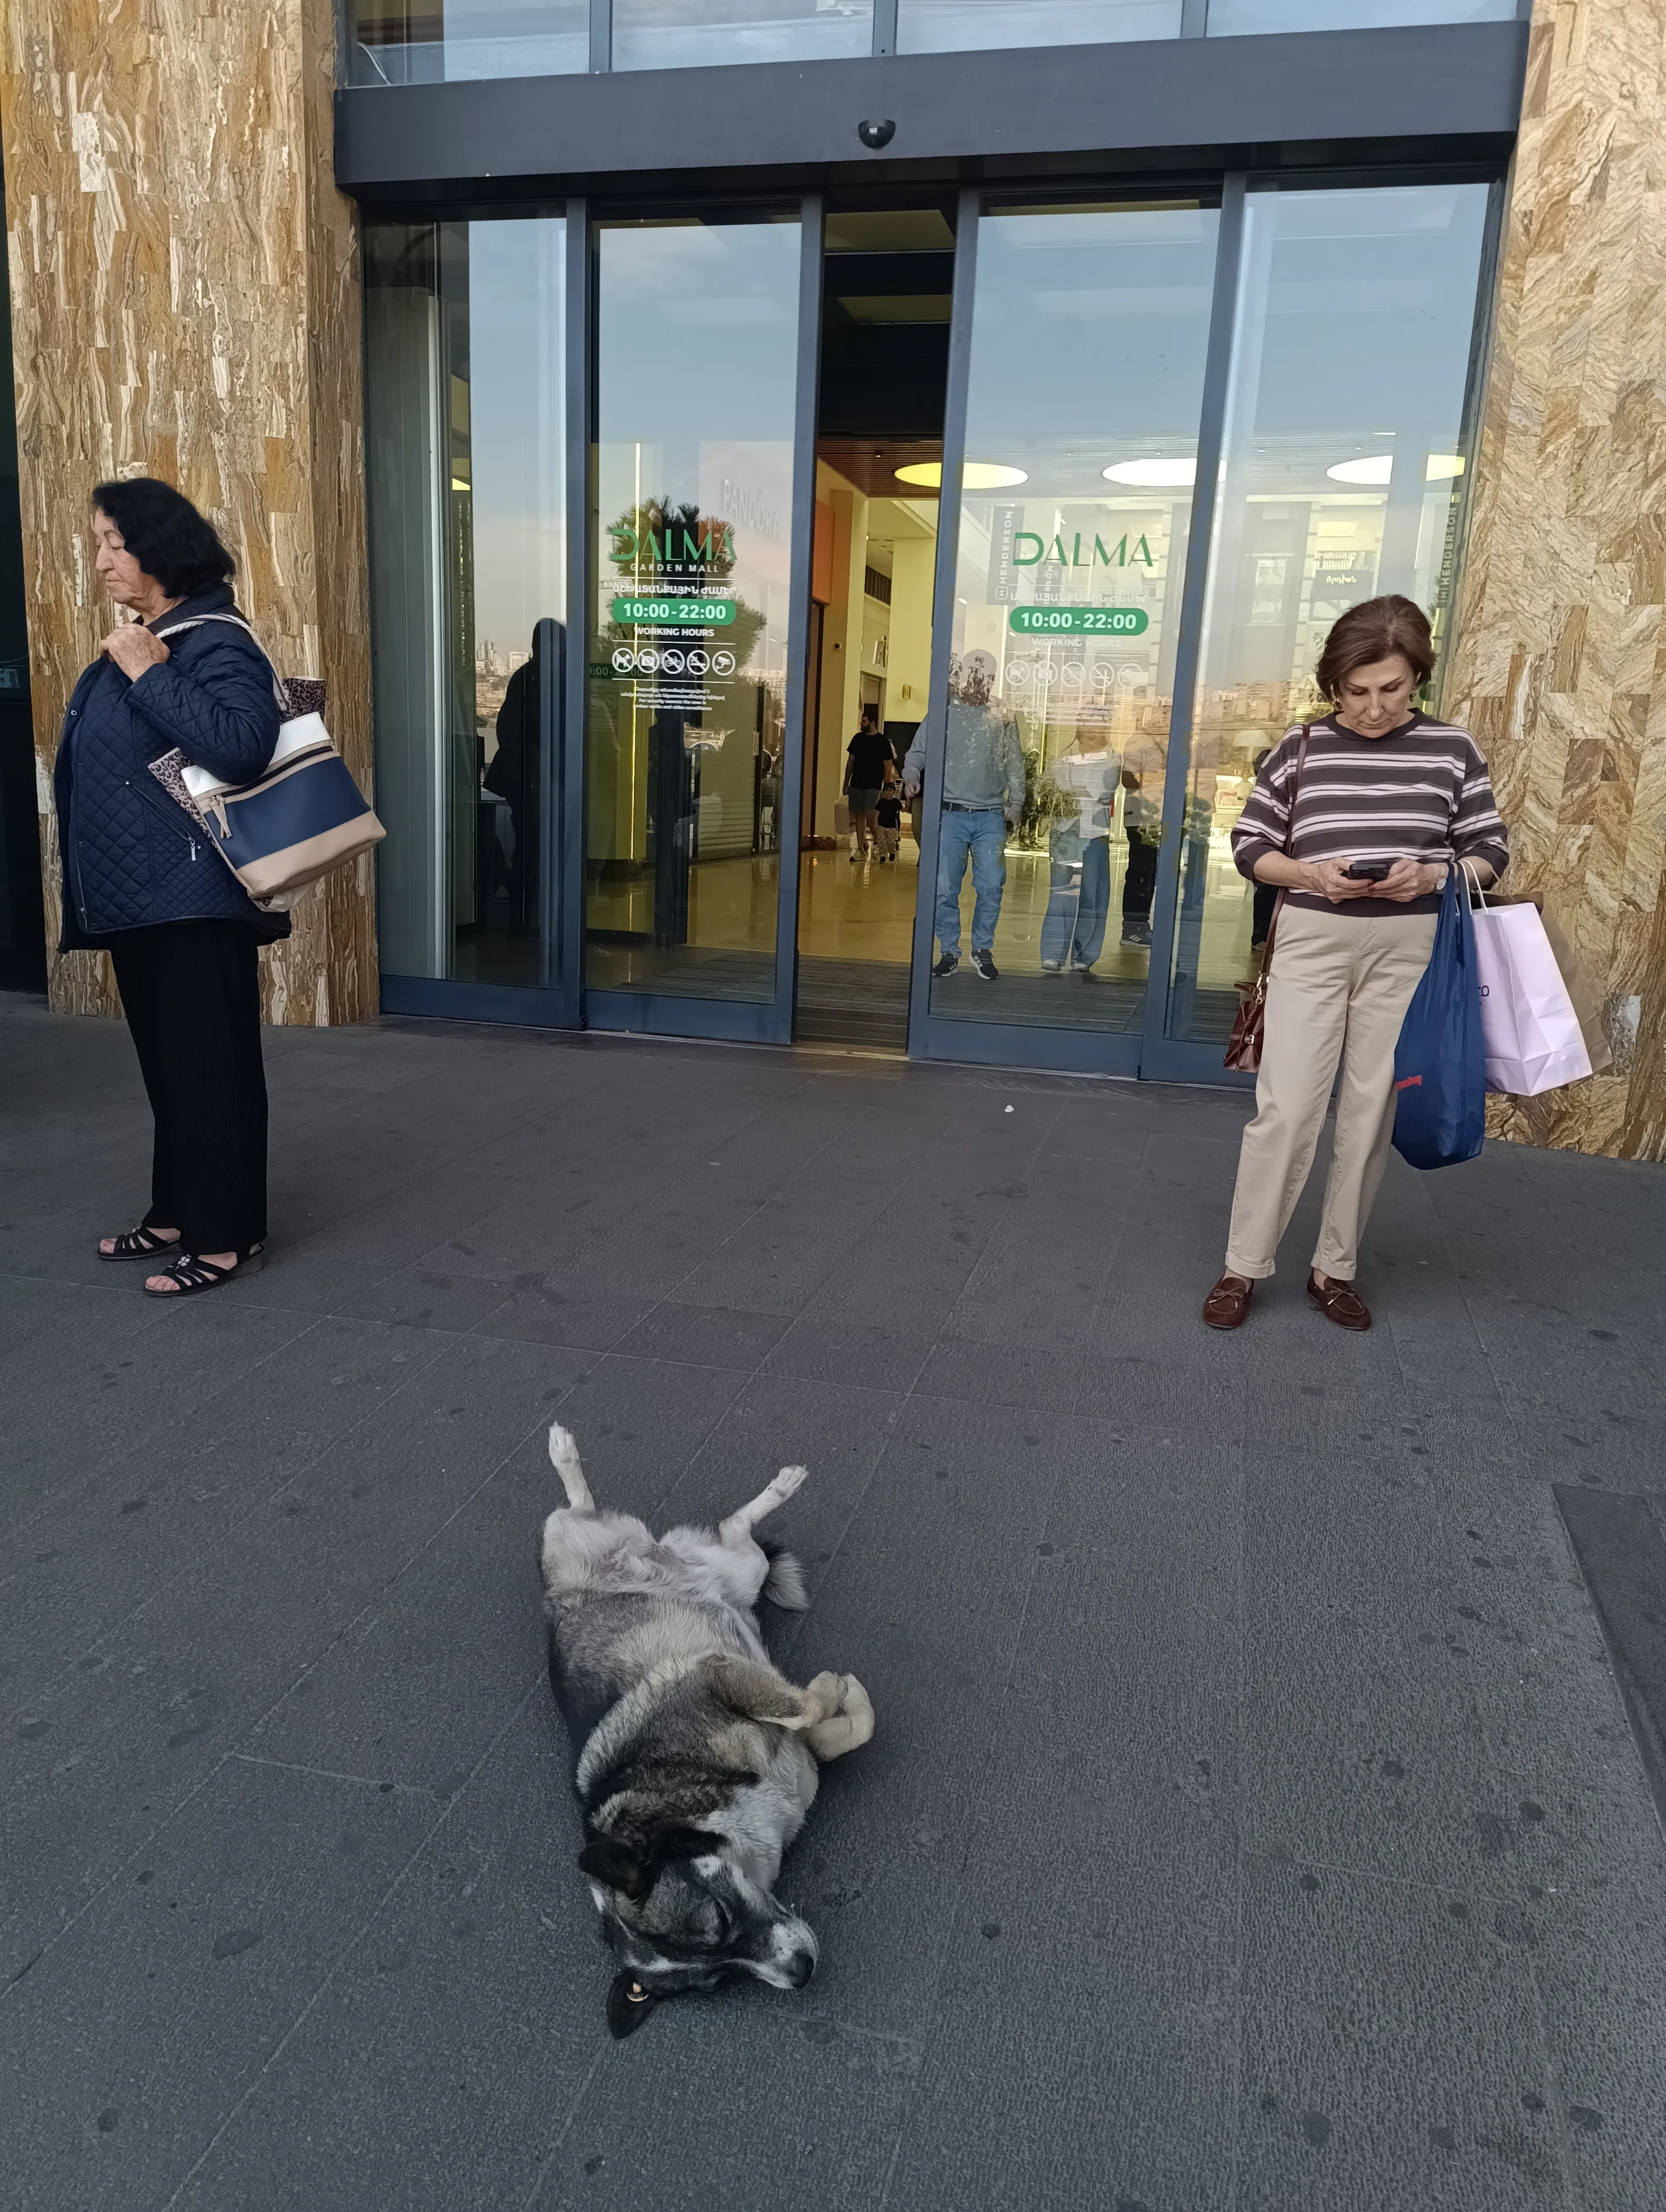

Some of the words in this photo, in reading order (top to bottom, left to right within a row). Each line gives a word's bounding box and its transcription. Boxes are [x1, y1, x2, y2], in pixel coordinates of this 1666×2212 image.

[723, 478, 780, 541] PANDORA
[611, 529, 738, 561] DALMA
[999, 511, 1013, 584] HENDERSON
[1012, 532, 1153, 567] DALMA
[1440, 507, 1457, 585] HENDERSON
[630, 564, 683, 572] GARDEN
[689, 564, 719, 572] MALL
[635, 627, 680, 636] WORKING
[681, 629, 715, 637] HOURS
[1031, 637, 1082, 647] WORKING
[1086, 639, 1122, 648] HOURS
